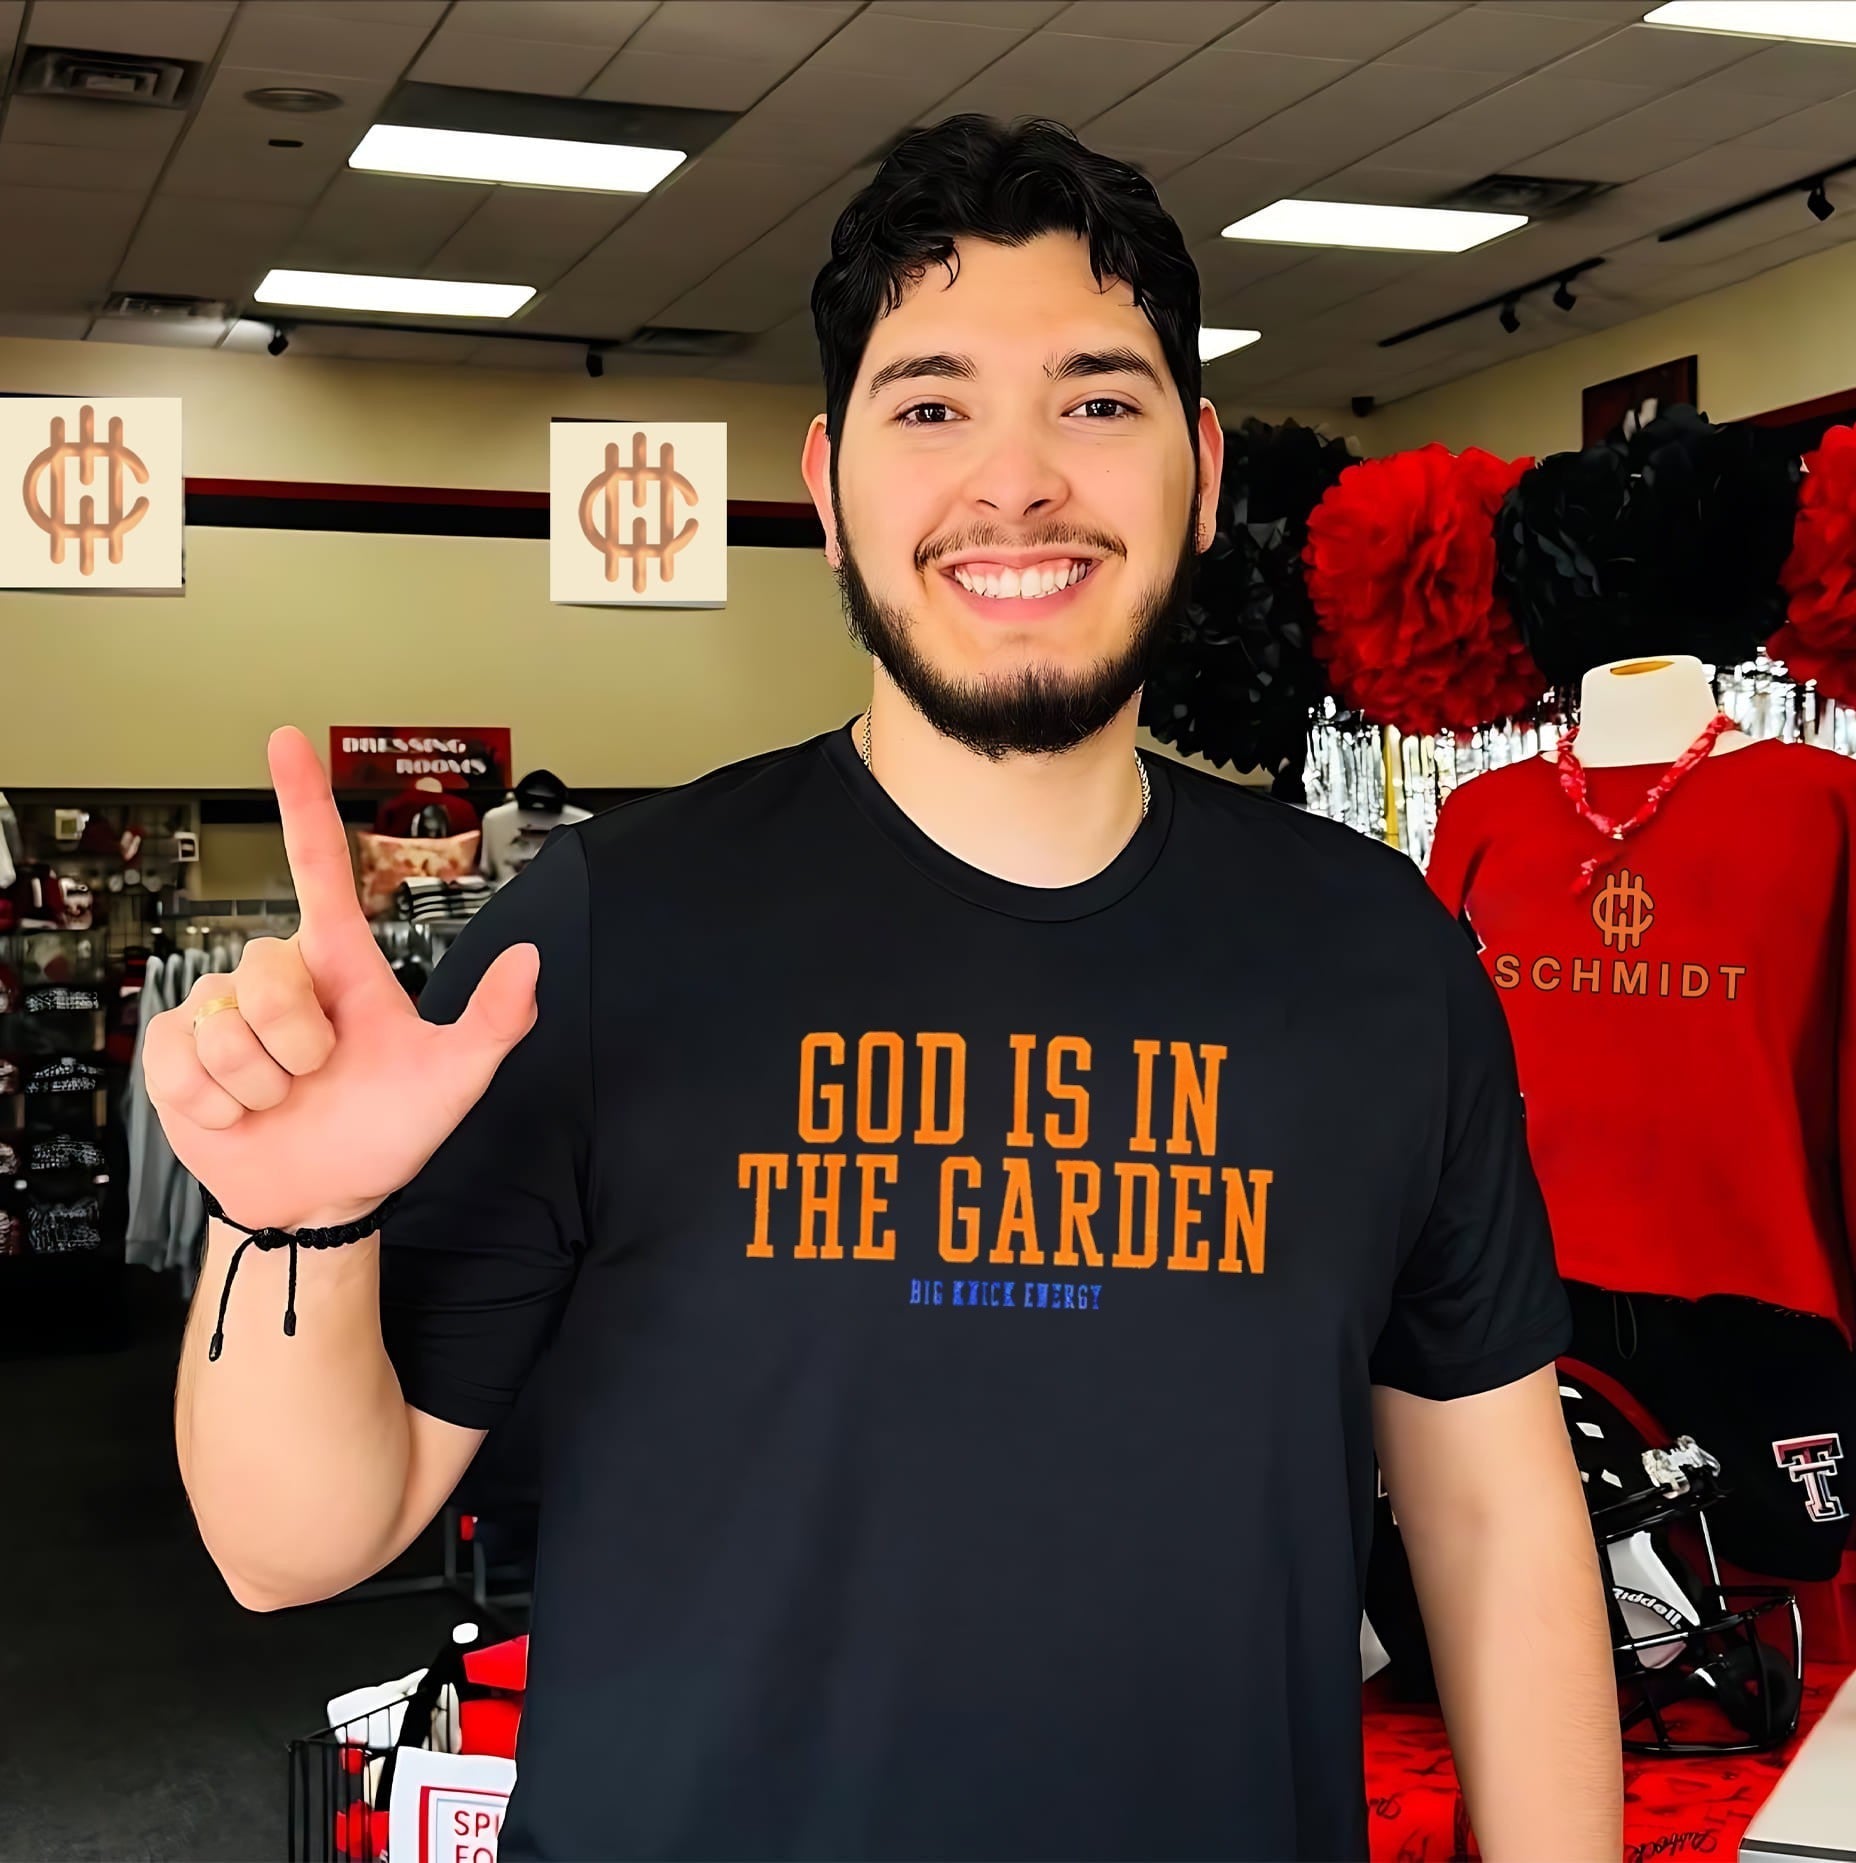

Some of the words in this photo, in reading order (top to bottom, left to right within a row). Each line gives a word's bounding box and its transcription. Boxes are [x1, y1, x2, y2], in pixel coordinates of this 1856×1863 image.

[342, 737, 467, 754] DRESSING
[396, 758, 487, 776] ROOMS
[1494, 954, 1747, 1000] SCHMIDT
[798, 1031, 967, 1145] GOD
[1006, 1034, 1092, 1149] IS
[1129, 1039, 1228, 1156] IN
[738, 1153, 899, 1261] THE
[938, 1156, 1274, 1274] GARDEN
[909, 1277, 944, 1306] BIG
[1023, 1282, 1102, 1310] ENERGY
